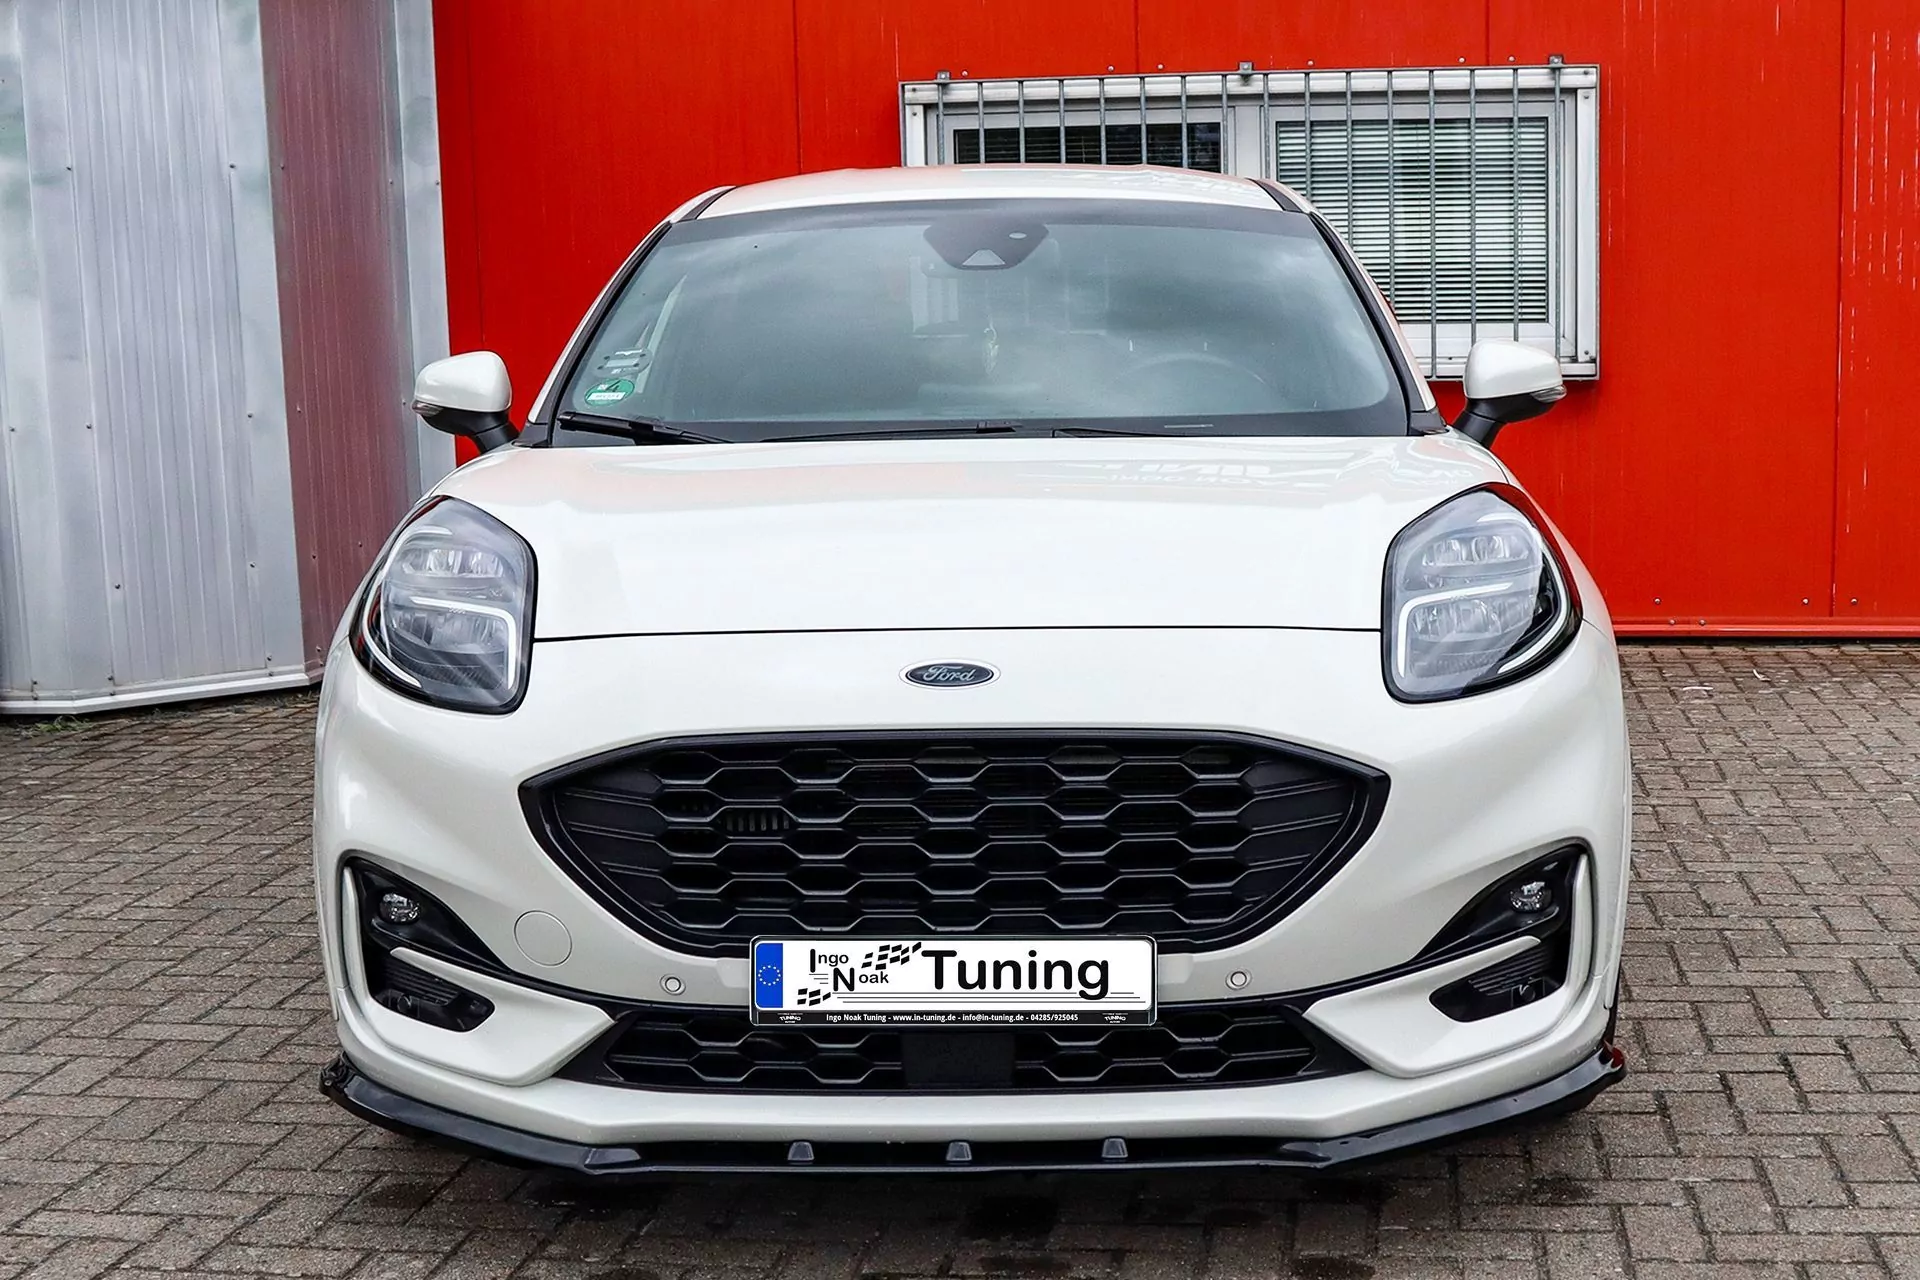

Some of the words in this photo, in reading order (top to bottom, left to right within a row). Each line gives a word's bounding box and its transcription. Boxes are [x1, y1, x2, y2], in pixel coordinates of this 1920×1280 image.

[923, 665, 976, 681] Ford
[809, 948, 849, 974] Ingo
[833, 968, 889, 992] Noak
[920, 949, 1109, 1000] Tuning
[826, 1013, 841, 1023] Ingo
[843, 1013, 862, 1021] Noak
[863, 1013, 887, 1023] Tuning
[892, 1013, 956, 1023] www.in-tuning.de
[962, 1013, 1024, 1023] info@in-tuning.de
[1030, 1013, 1079, 1022] 04285/925045
